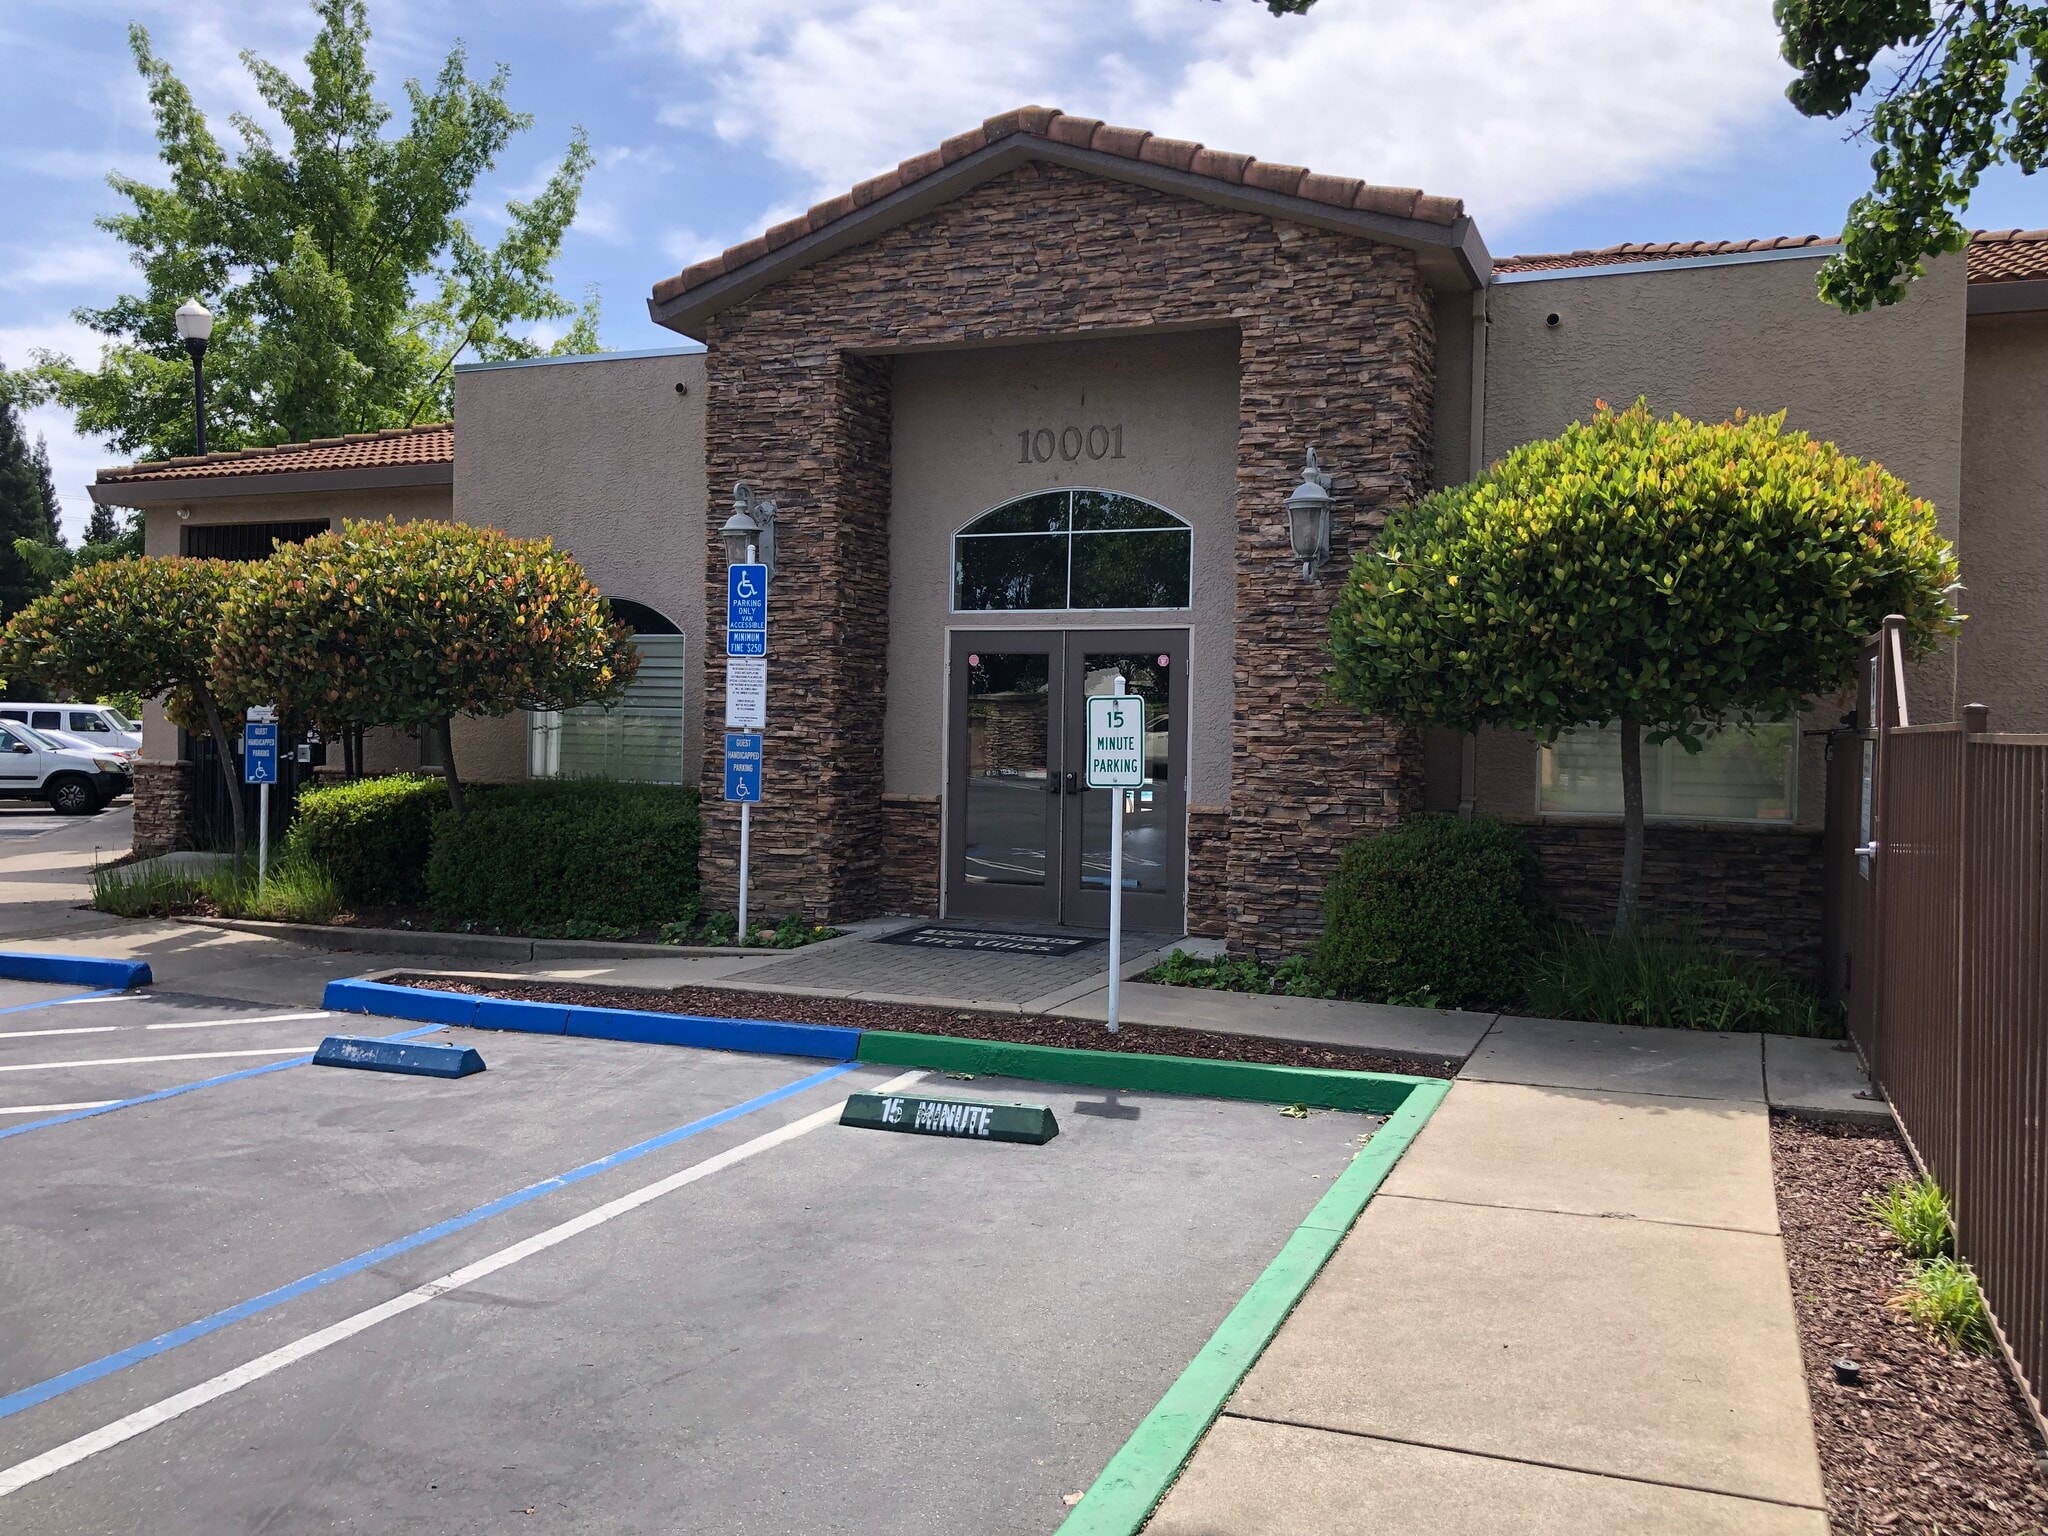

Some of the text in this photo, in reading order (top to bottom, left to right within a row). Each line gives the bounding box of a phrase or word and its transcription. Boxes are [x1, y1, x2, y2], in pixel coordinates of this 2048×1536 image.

[1017, 423, 1126, 463] 10001
[732, 599, 762, 607] PARKING
[738, 607, 756, 615] ONLY
[730, 621, 765, 629] ACCESSIBLE
[733, 632, 760, 642] MINIMUM
[730, 643, 762, 653] FINE $250
[1106, 711, 1124, 728] 15
[735, 738, 751, 747] GUEST
[1097, 736, 1135, 751] MINUTE
[252, 749, 270, 757] PARKING
[727, 751, 760, 760] HANDICAPPED
[733, 763, 753, 773] PARKING
[1093, 758, 1138, 773] PARKING
[881, 1098, 994, 1136] 15 MINUTE
